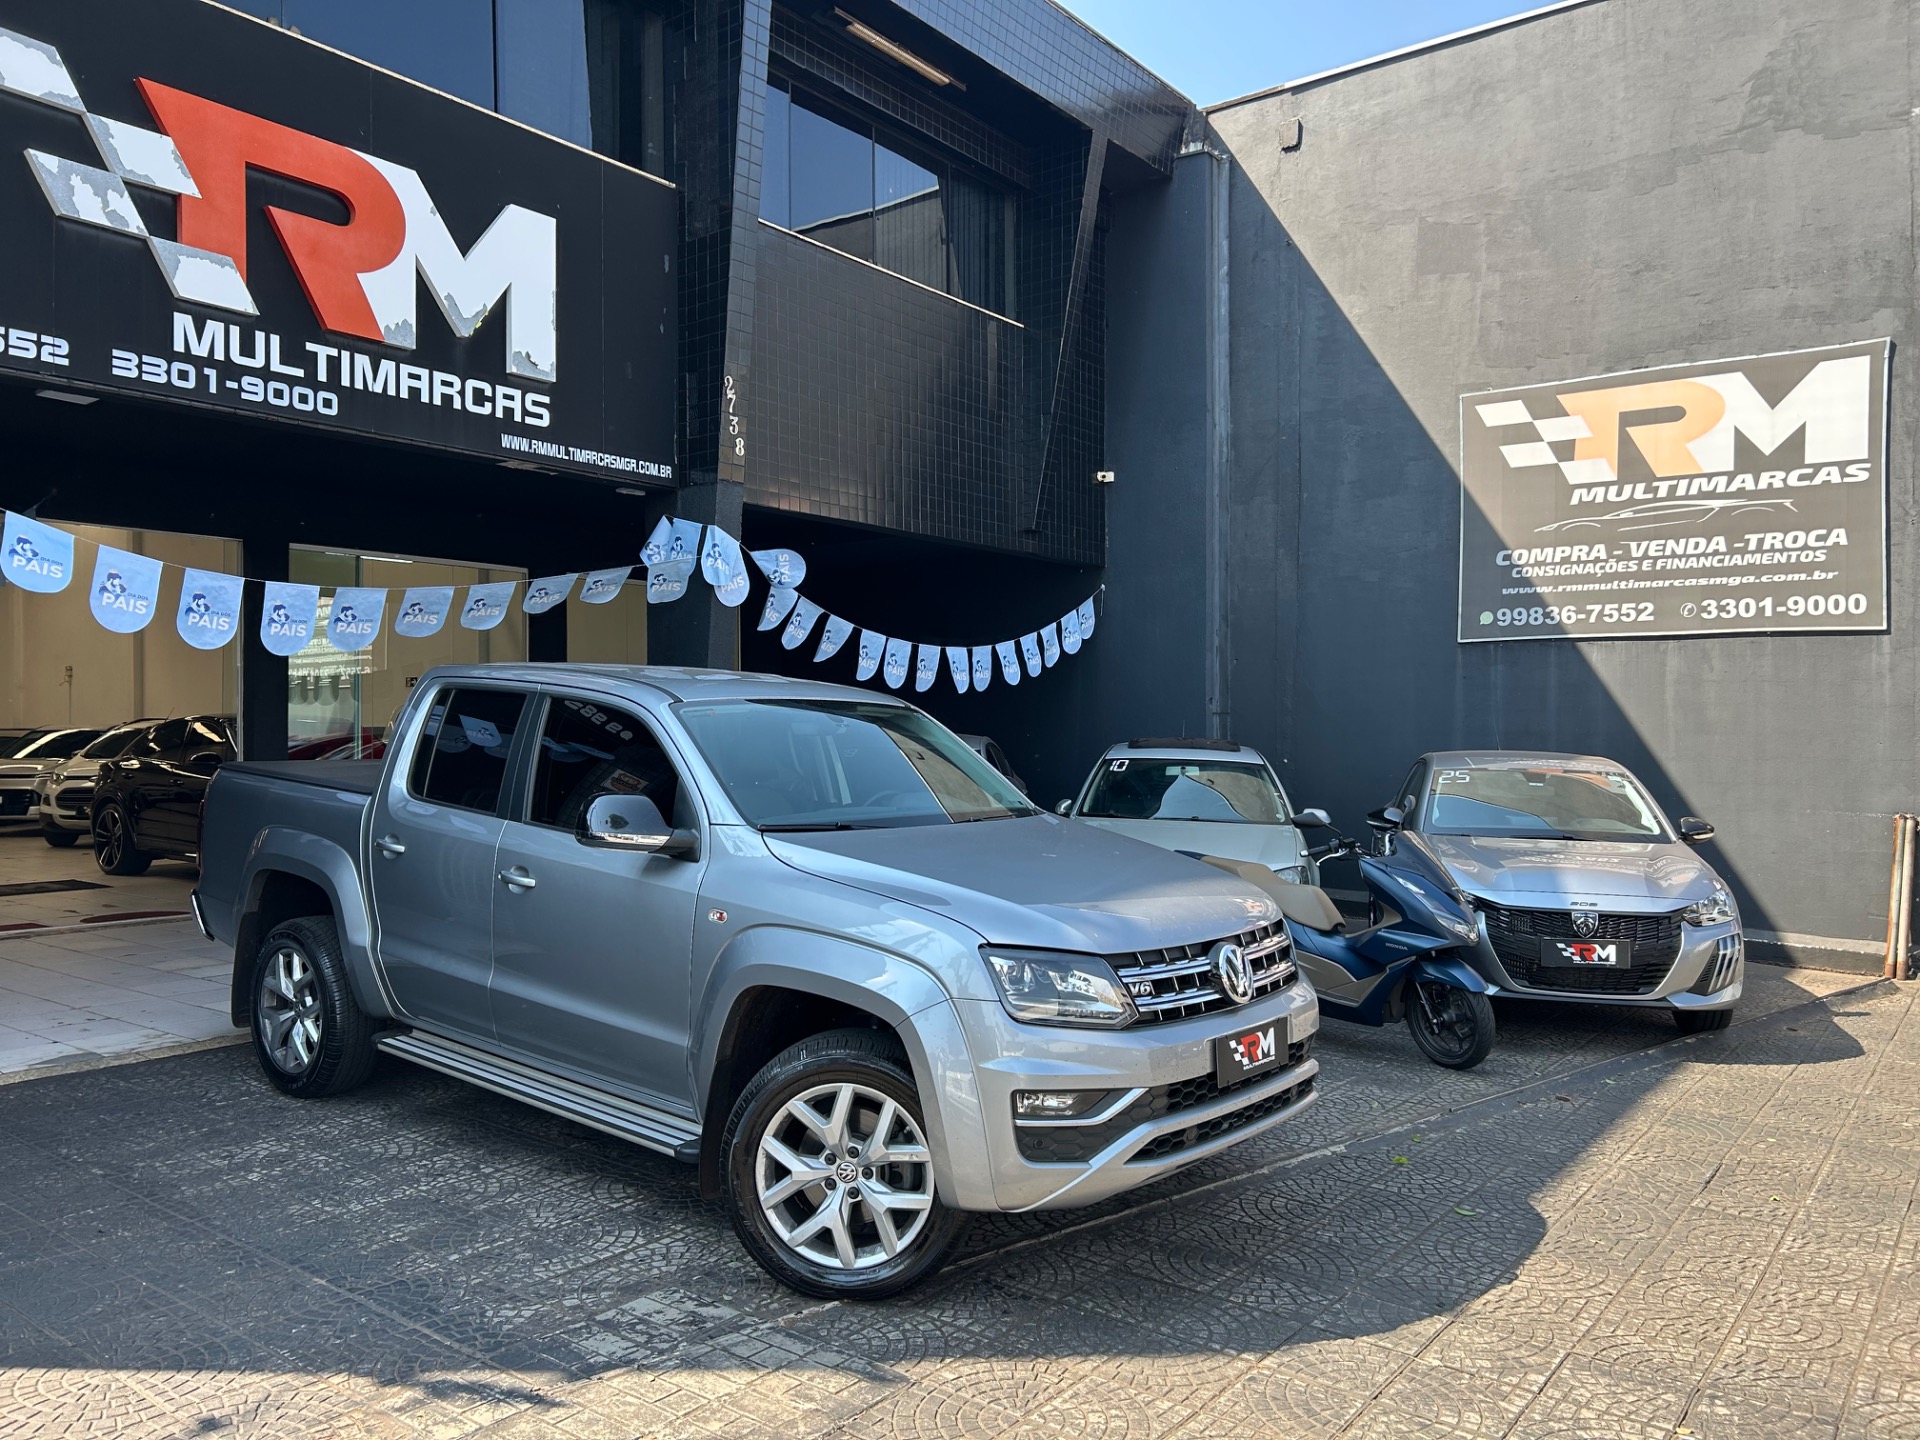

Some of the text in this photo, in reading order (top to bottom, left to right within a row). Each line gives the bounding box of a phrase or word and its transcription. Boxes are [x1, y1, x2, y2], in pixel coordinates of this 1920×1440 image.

[173, 311, 550, 428] MULTIMARCAS
[111, 348, 339, 416] 3301-9000
[501, 433, 672, 479] WWW.RMMULTIMARCASMGA.COM.BR
[1570, 462, 1872, 506] MULTIMARCAS
[1495, 543, 1608, 567] COMPRA
[1620, 535, 1728, 558] VENDA
[12, 554, 63, 579] PAIS
[1511, 549, 1827, 578] CONSIGNAÇÕES E FINANCIAMENTOS
[651, 582, 682, 593] PAIS
[721, 576, 745, 593] PAIS
[1502, 570, 1839, 595] www.rmmultimarcasmga.com.br
[101, 592, 149, 615] PAIS
[468, 606, 500, 618] PAIS
[1496, 602, 1655, 627] 99836-7552
[1700, 593, 1868, 620] 3301-9000
[187, 612, 230, 631] PAIS
[270, 623, 307, 637] PAIS
[336, 623, 372, 634] PAIS
[403, 614, 439, 625] PAIS
[1110, 759, 1129, 771] 10
[1438, 770, 1470, 783] 25
[1128, 981, 1151, 996] V6
